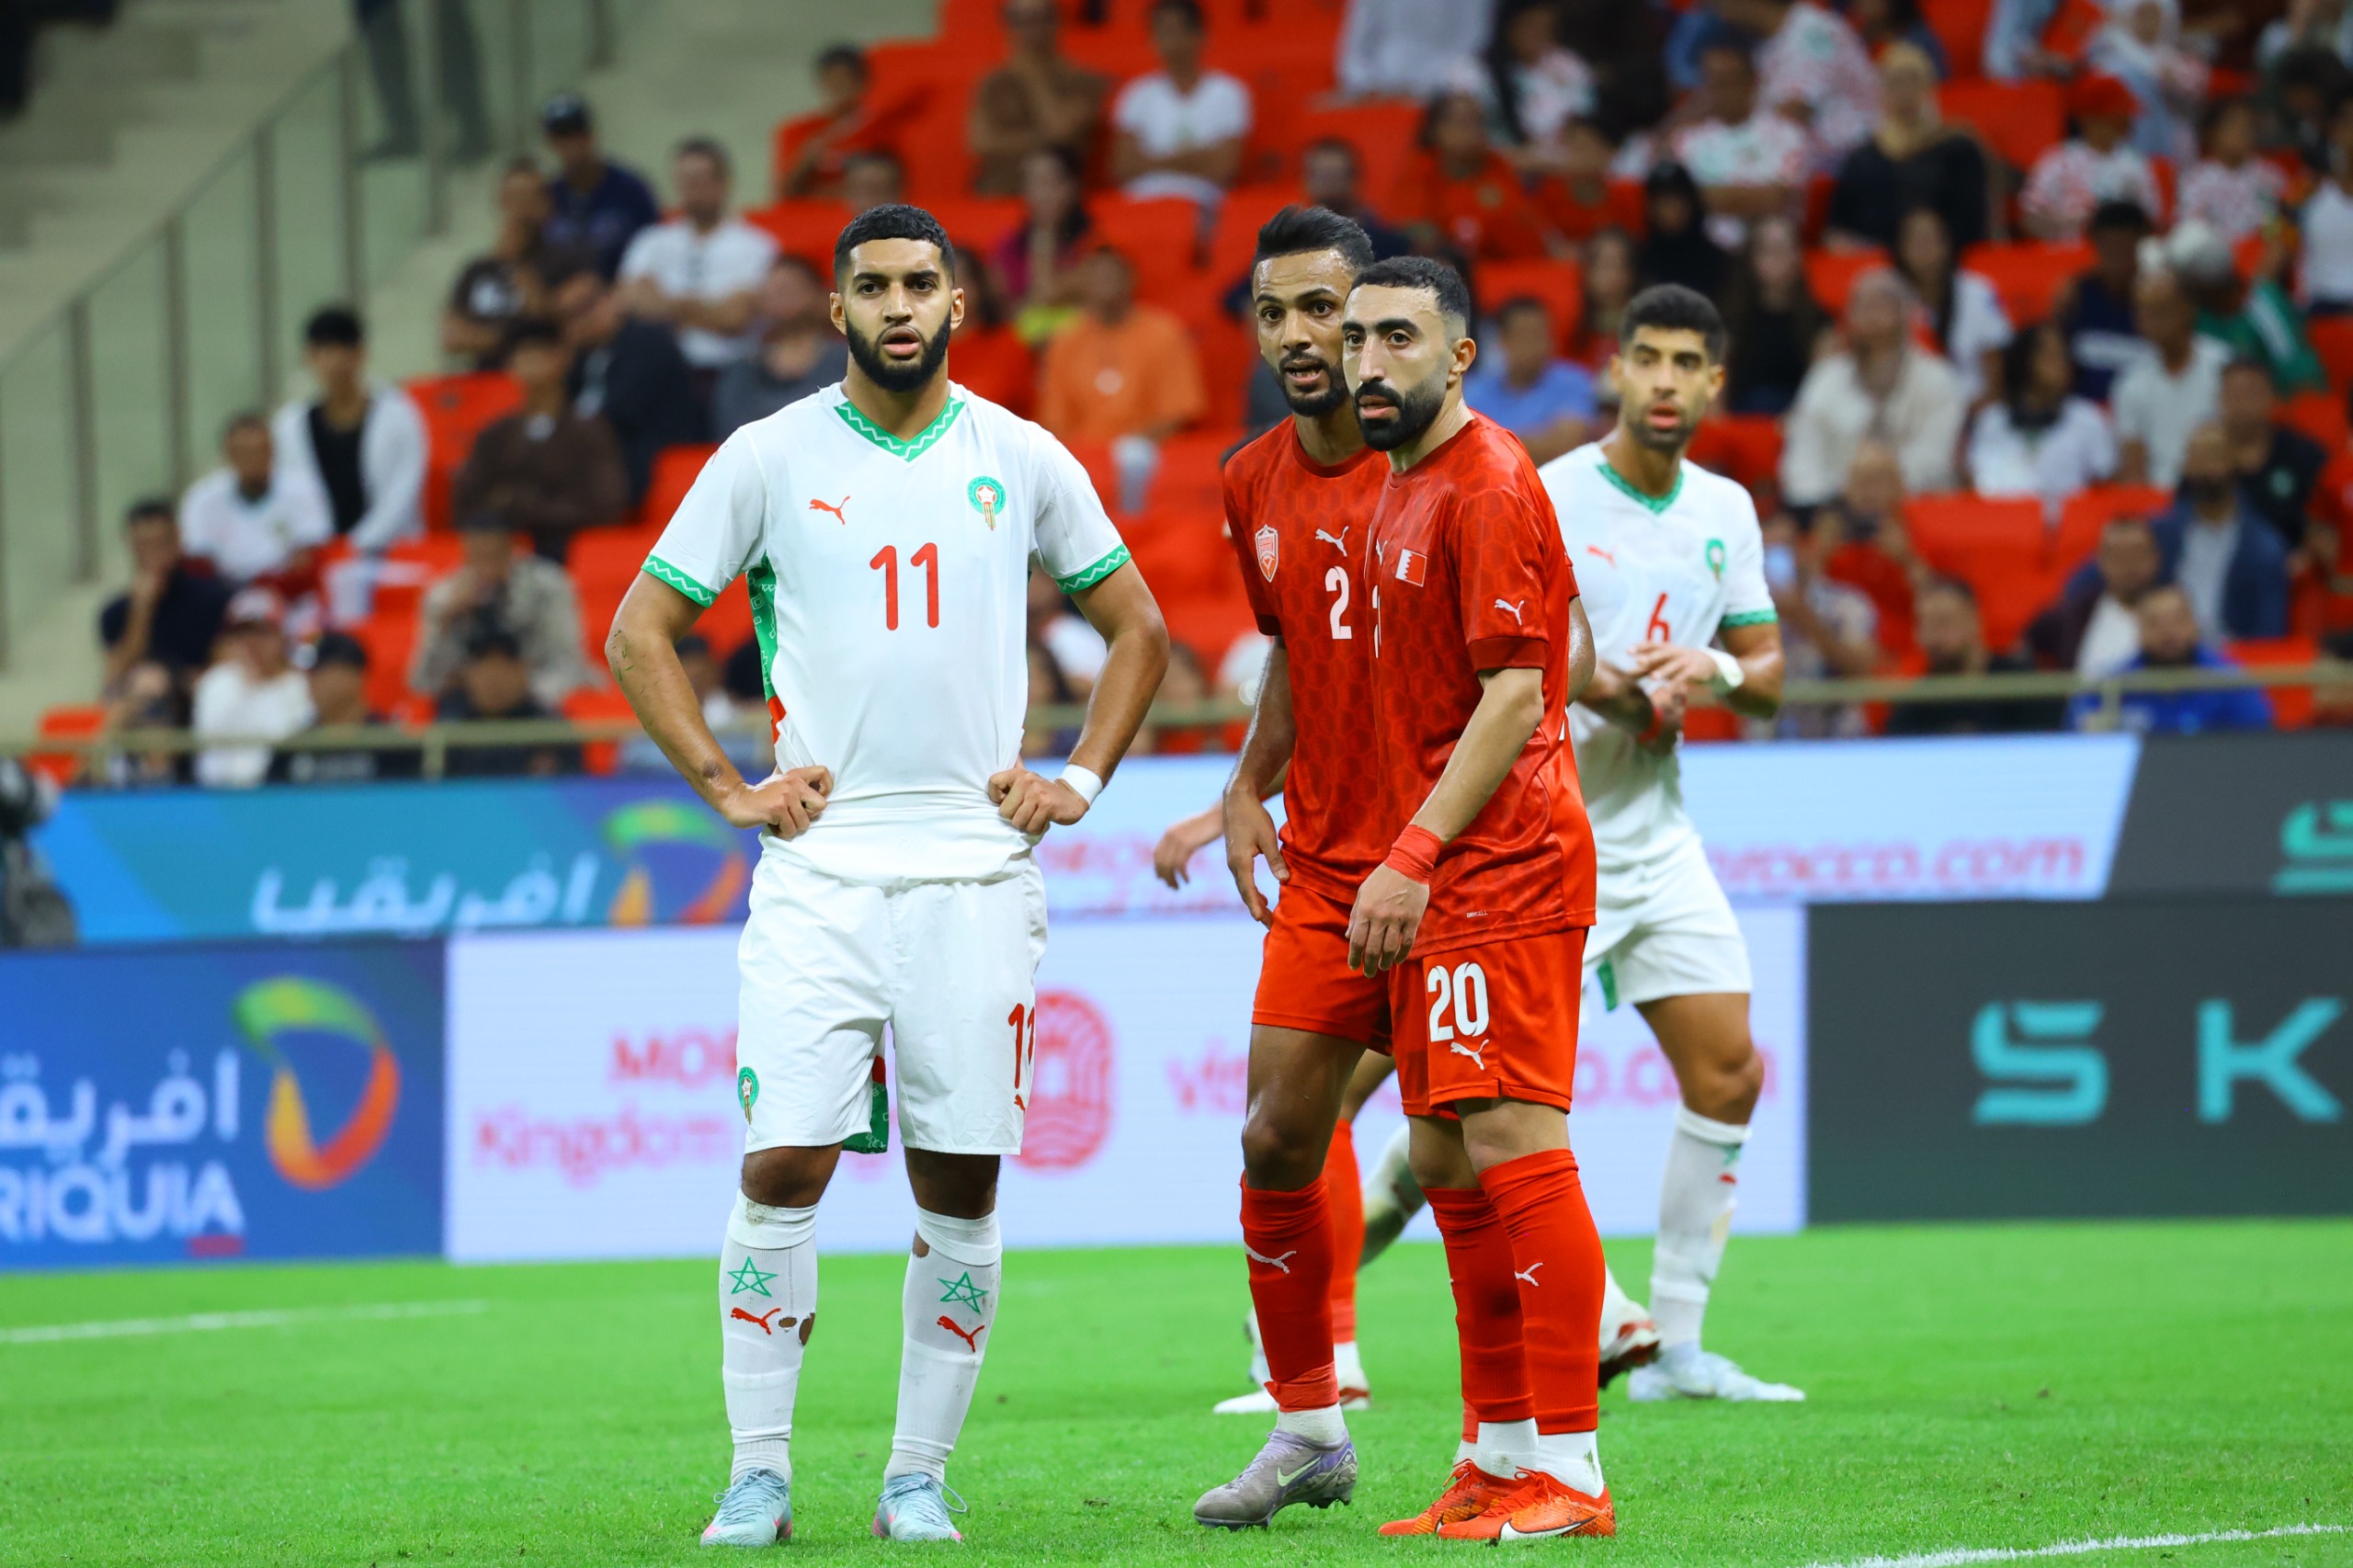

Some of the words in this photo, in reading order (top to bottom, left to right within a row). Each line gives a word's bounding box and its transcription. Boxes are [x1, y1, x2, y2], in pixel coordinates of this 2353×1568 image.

[870, 542, 939, 631] 11
[1324, 565, 1353, 641] 2
[1646, 591, 1670, 643] 6
[1427, 961, 1490, 1042] 20
